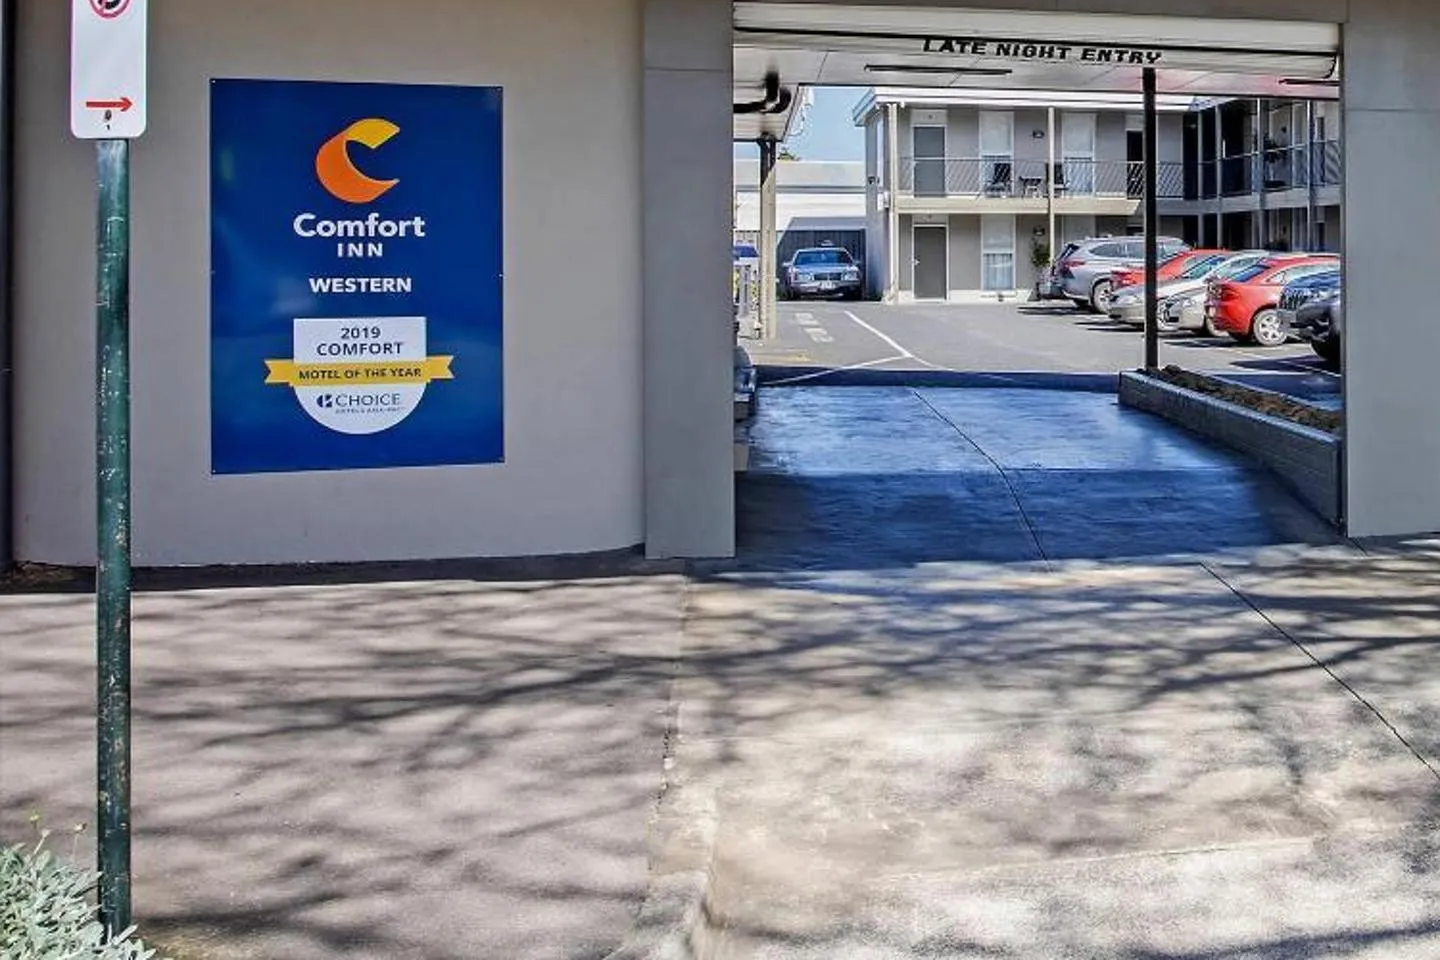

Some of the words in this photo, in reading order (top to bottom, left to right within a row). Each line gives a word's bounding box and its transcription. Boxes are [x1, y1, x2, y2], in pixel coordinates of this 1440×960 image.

[922, 38, 987, 54] LATE
[995, 43, 1072, 60] NIGHT
[1080, 47, 1163, 64] ENTRY
[293, 212, 426, 237] Comfort
[337, 242, 383, 257] INN
[308, 277, 412, 293] WESTERN
[340, 326, 381, 340] 2019
[315, 342, 403, 356] COMFORT
[299, 369, 341, 380] MOTEL
[343, 369, 361, 379] OF
[365, 368, 387, 378] THE
[391, 367, 422, 378] YEAR
[335, 392, 402, 407] CHOICE
